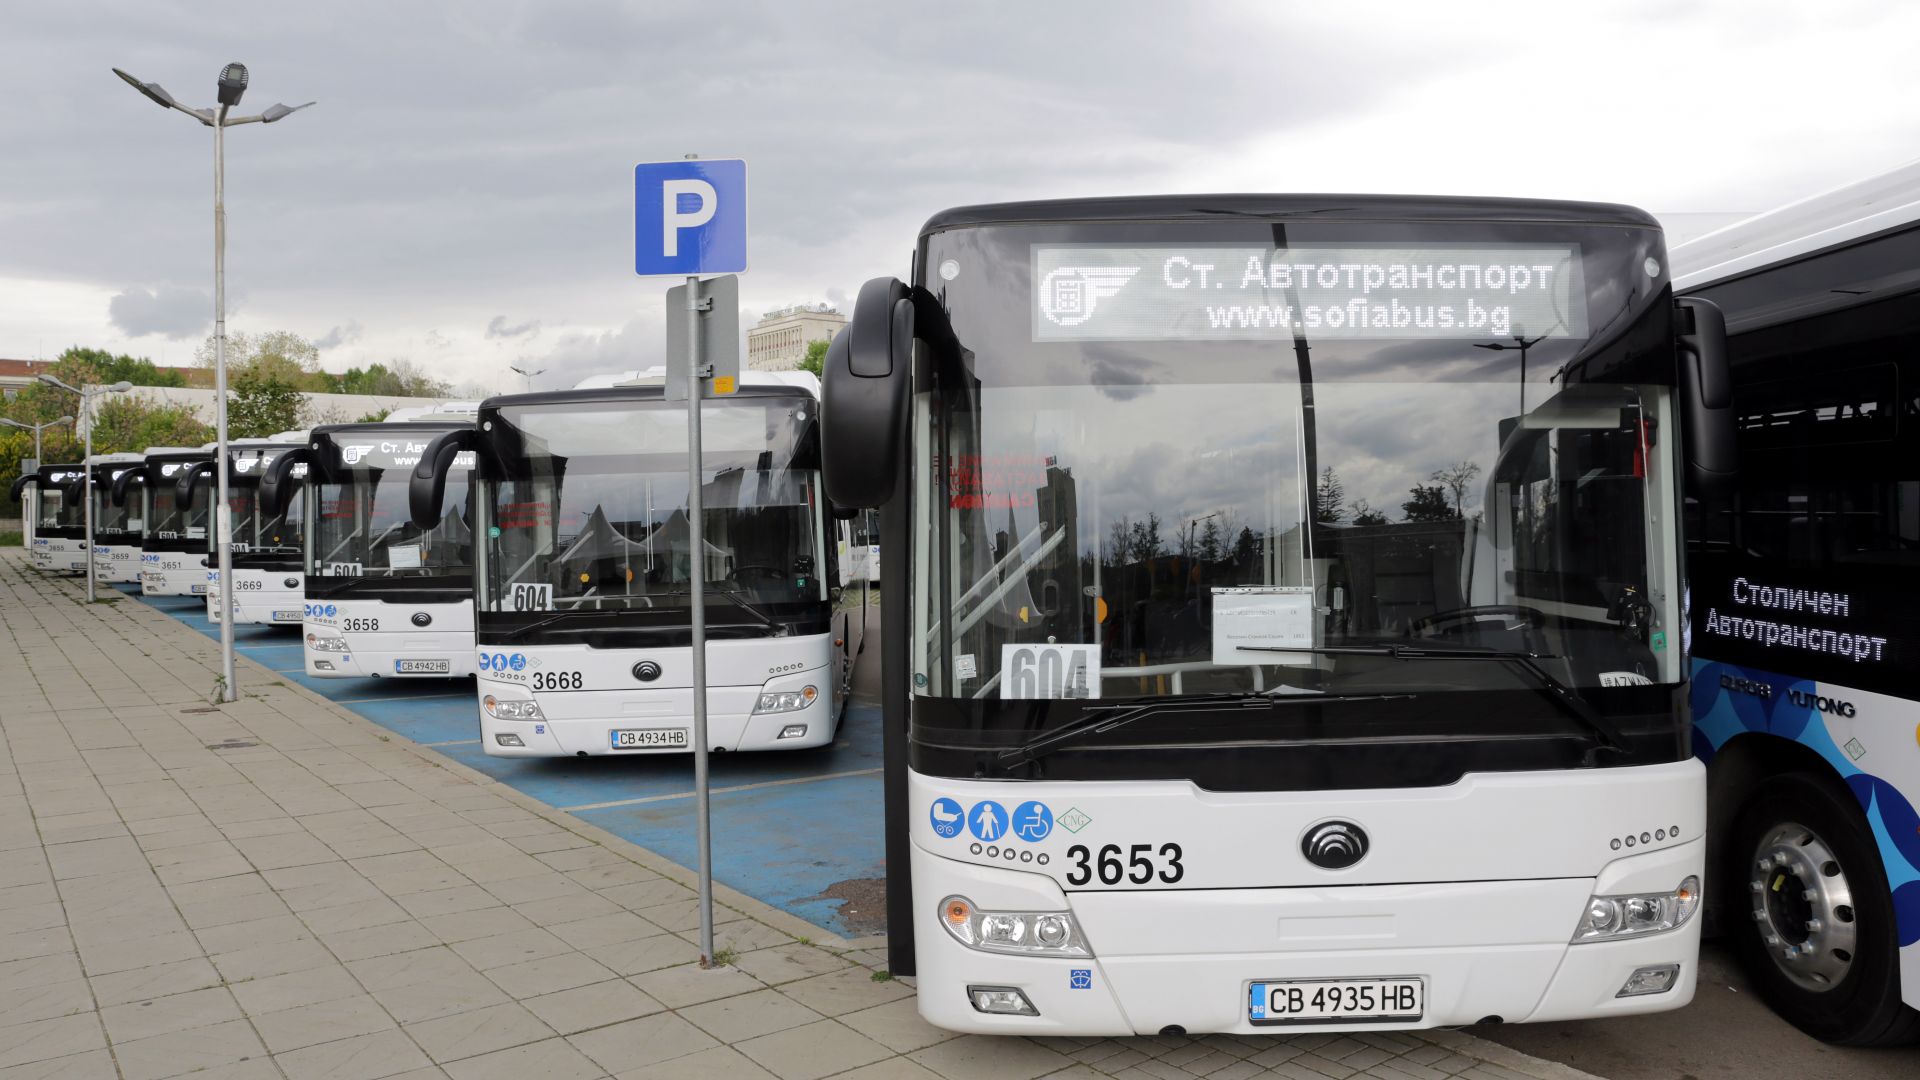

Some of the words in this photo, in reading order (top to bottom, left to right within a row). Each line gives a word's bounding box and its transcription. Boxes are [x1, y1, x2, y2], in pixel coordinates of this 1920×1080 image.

[663, 179, 718, 257] P
[1163, 256, 1223, 289] Ст.
[1239, 256, 1553, 294] Автотранспорт
[1206, 298, 1510, 336] www.sofiabus.bg
[381, 442, 401, 453] Ст.
[161, 561, 181, 570] 3651
[236, 580, 262, 590] 3669
[514, 585, 547, 611] 604
[1733, 577, 1849, 617] Столичен
[343, 618, 379, 631] 3658
[1705, 607, 1887, 663] Автотранспорт
[402, 662, 413, 671] CB
[415, 662, 435, 671] 4942
[436, 662, 447, 671] HB
[533, 671, 583, 690] 3668
[1011, 648, 1090, 699] 604
[1786, 688, 1857, 718] YUTONG
[620, 732, 636, 744] CB
[638, 732, 666, 744] 4934
[668, 731, 684, 743] HB
[1063, 815, 1085, 827] CNG
[1066, 842, 1184, 885] 3653
[1253, 1005, 1265, 1014] BG
[1270, 988, 1305, 1013] CB
[1311, 986, 1376, 1012] 4935
[1382, 984, 1416, 1011] HB
